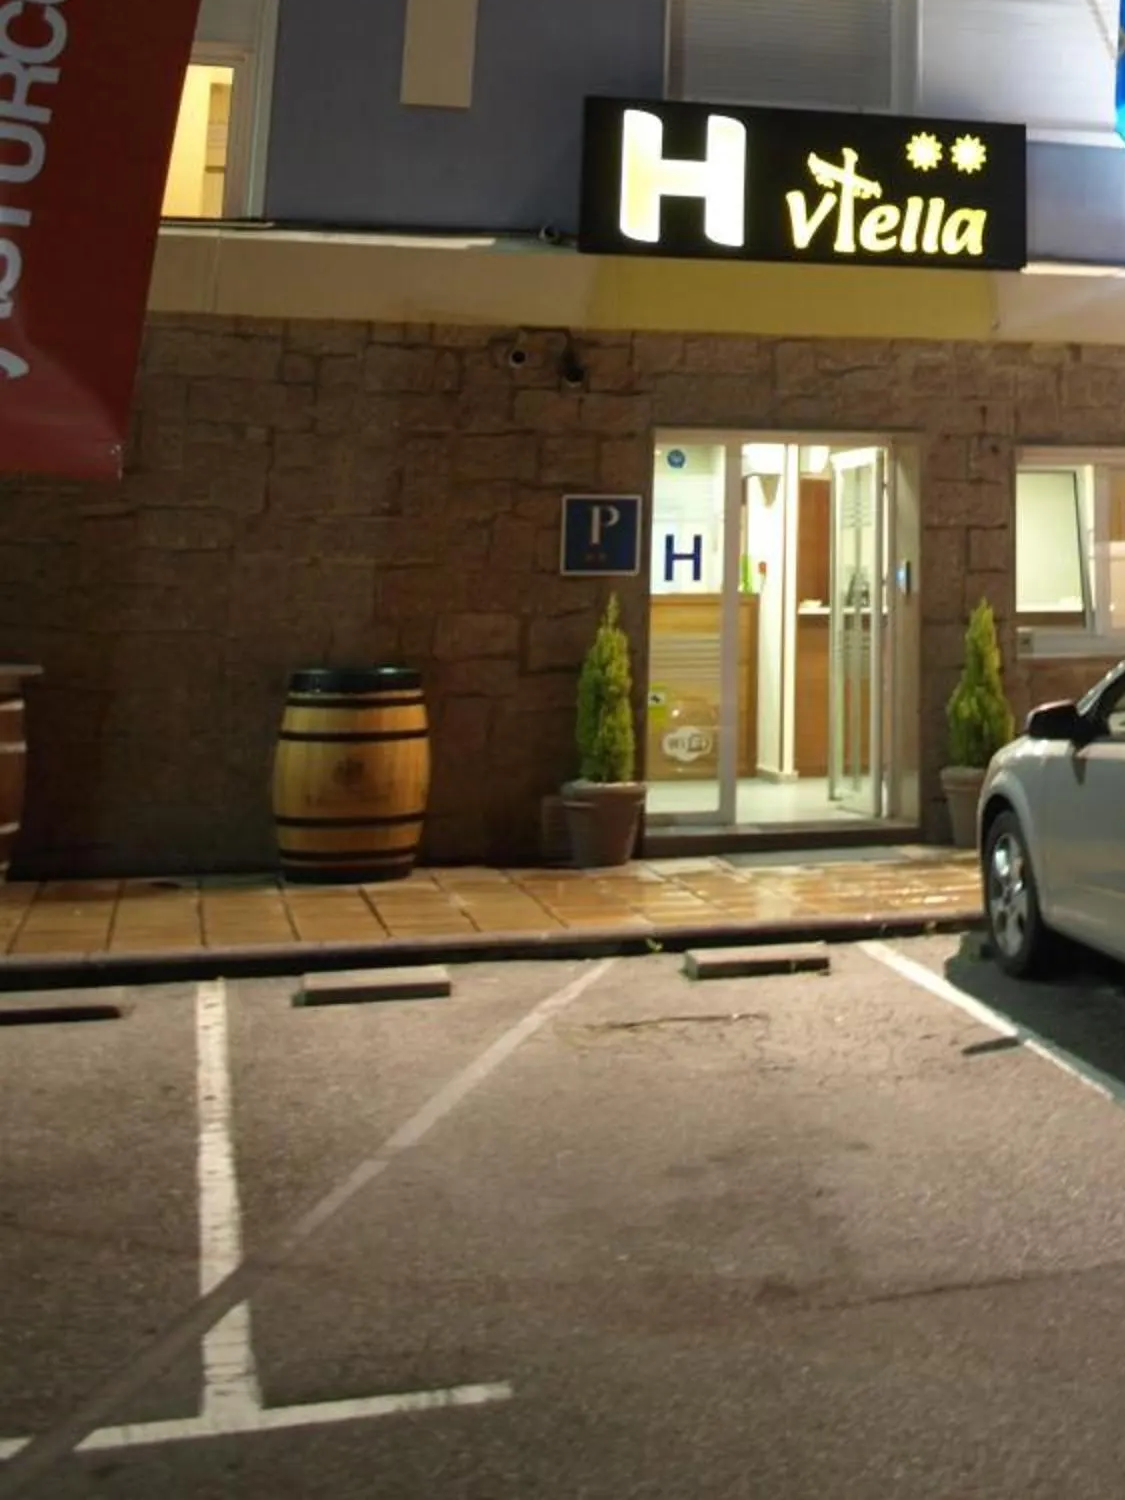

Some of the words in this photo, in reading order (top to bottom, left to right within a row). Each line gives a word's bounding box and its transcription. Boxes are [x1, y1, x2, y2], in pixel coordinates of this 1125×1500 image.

[619, 108, 747, 248] H
[590, 504, 621, 546] P
[664, 533, 703, 583] H
